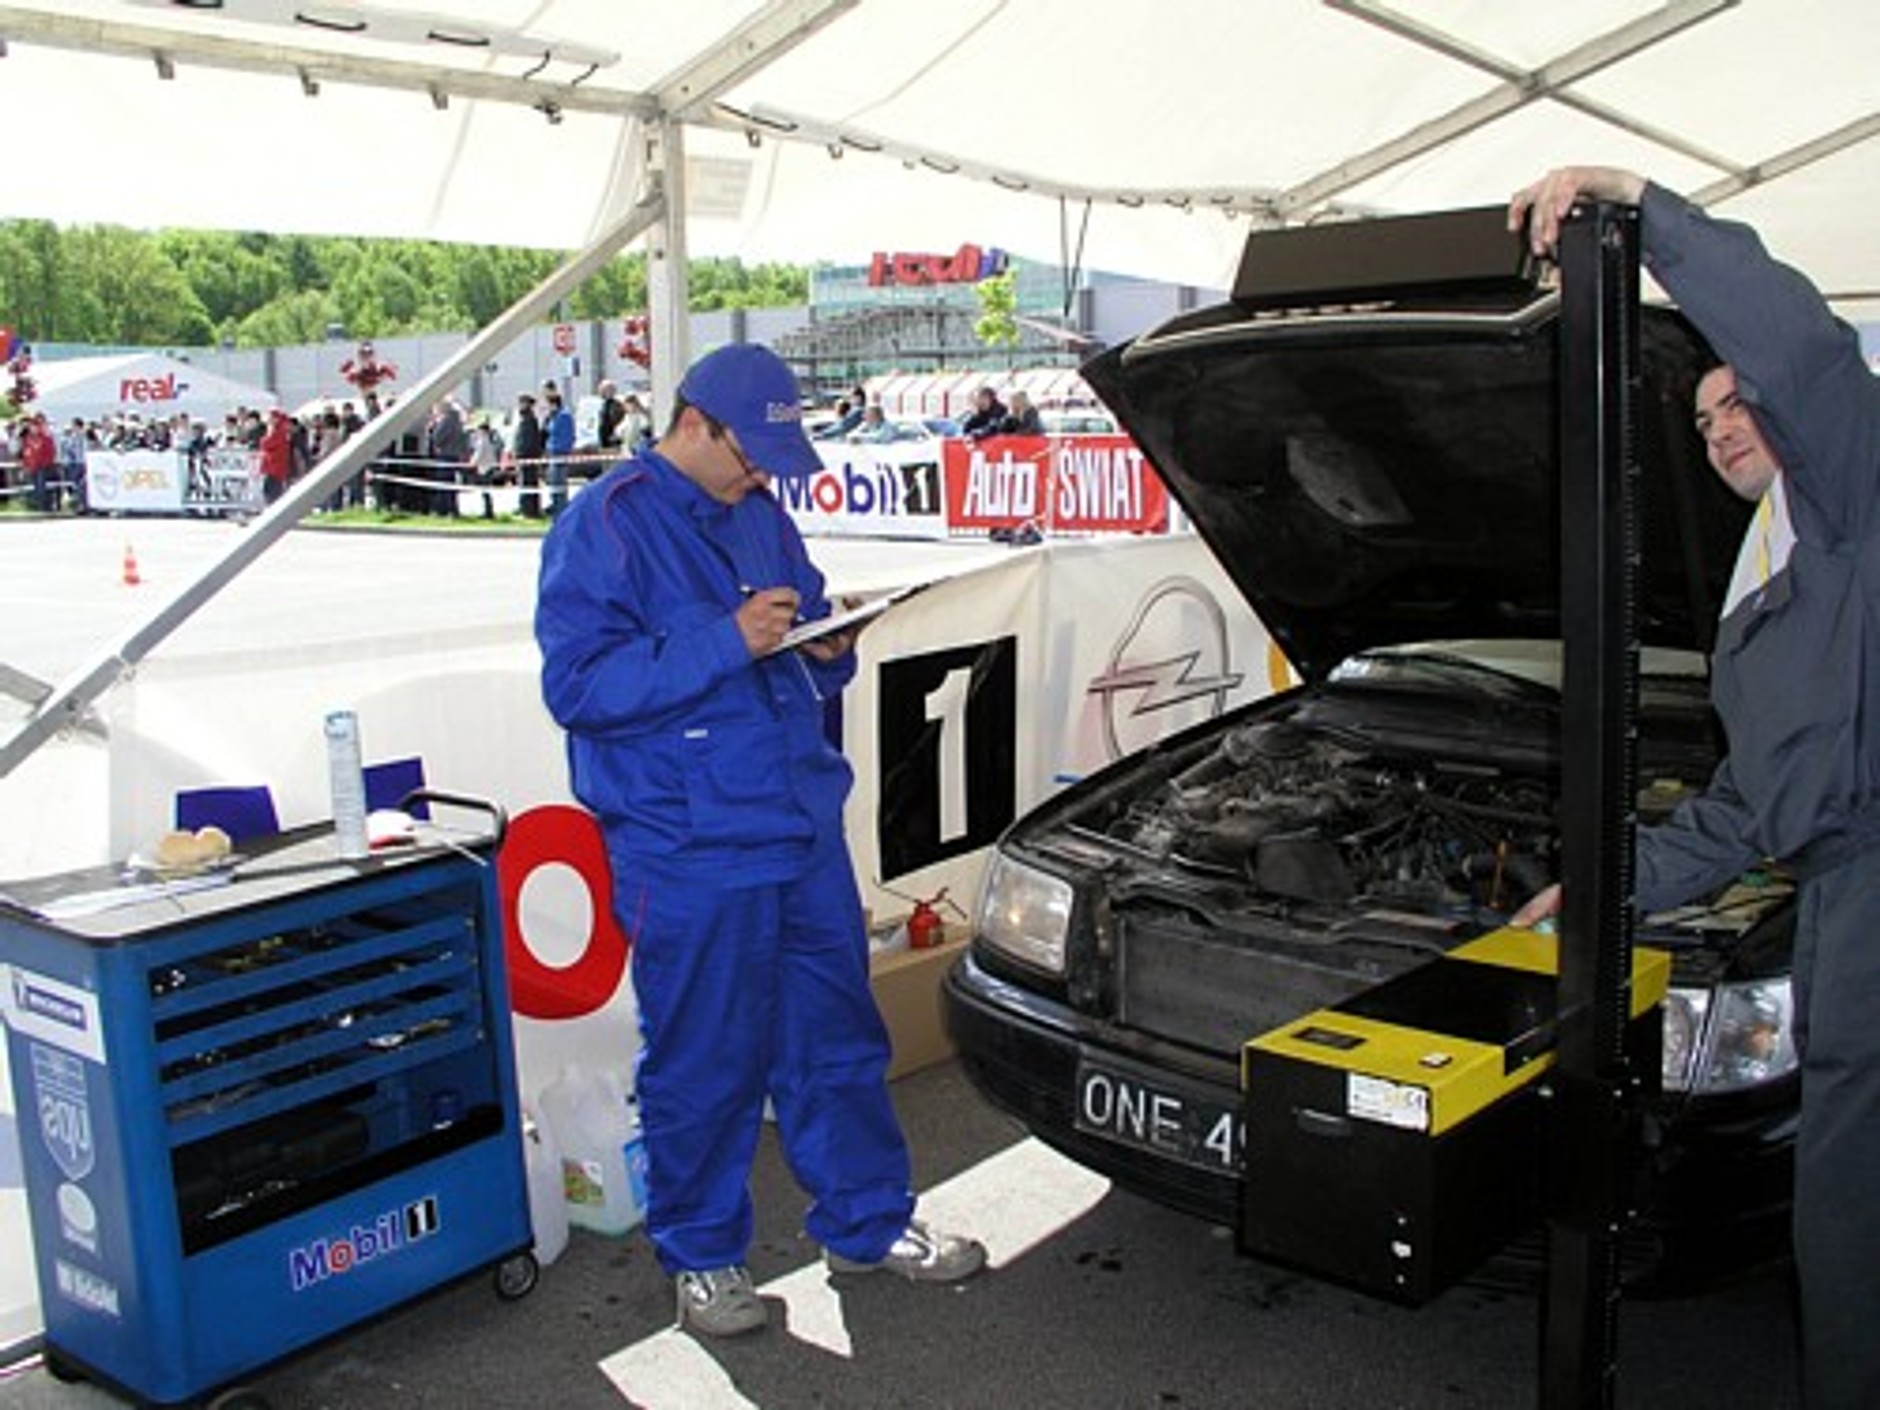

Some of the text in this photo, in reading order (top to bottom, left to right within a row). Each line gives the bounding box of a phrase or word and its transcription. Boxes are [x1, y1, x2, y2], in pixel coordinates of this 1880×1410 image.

[777, 462, 898, 515] Mobil
[962, 440, 1144, 520] Auto ŚWIAT
[924, 665, 972, 844] 1
[1084, 1075, 1247, 1170] ONE 4
[290, 1196, 440, 1291] Mobil 1
